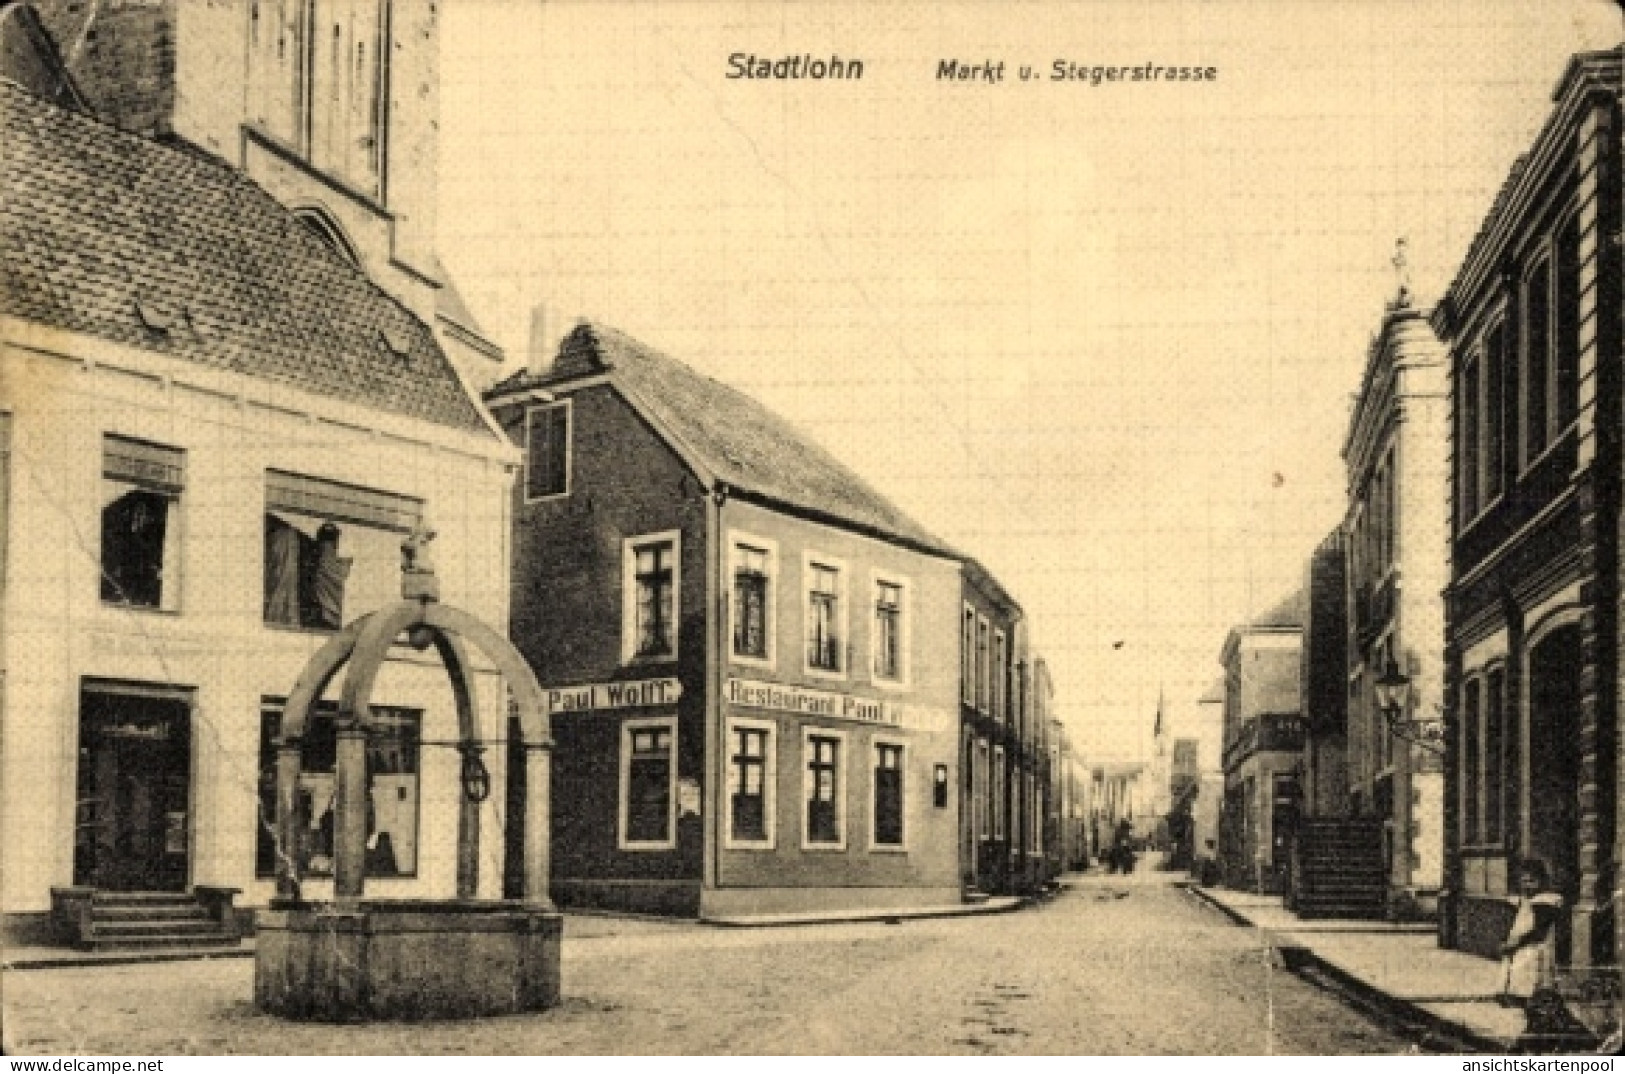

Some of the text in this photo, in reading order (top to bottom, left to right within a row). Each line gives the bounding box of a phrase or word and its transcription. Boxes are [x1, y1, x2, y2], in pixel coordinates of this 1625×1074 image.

[550, 686, 596, 711] Paul
[730, 679, 837, 714] Restaurant
[843, 696, 885, 721] Paul
